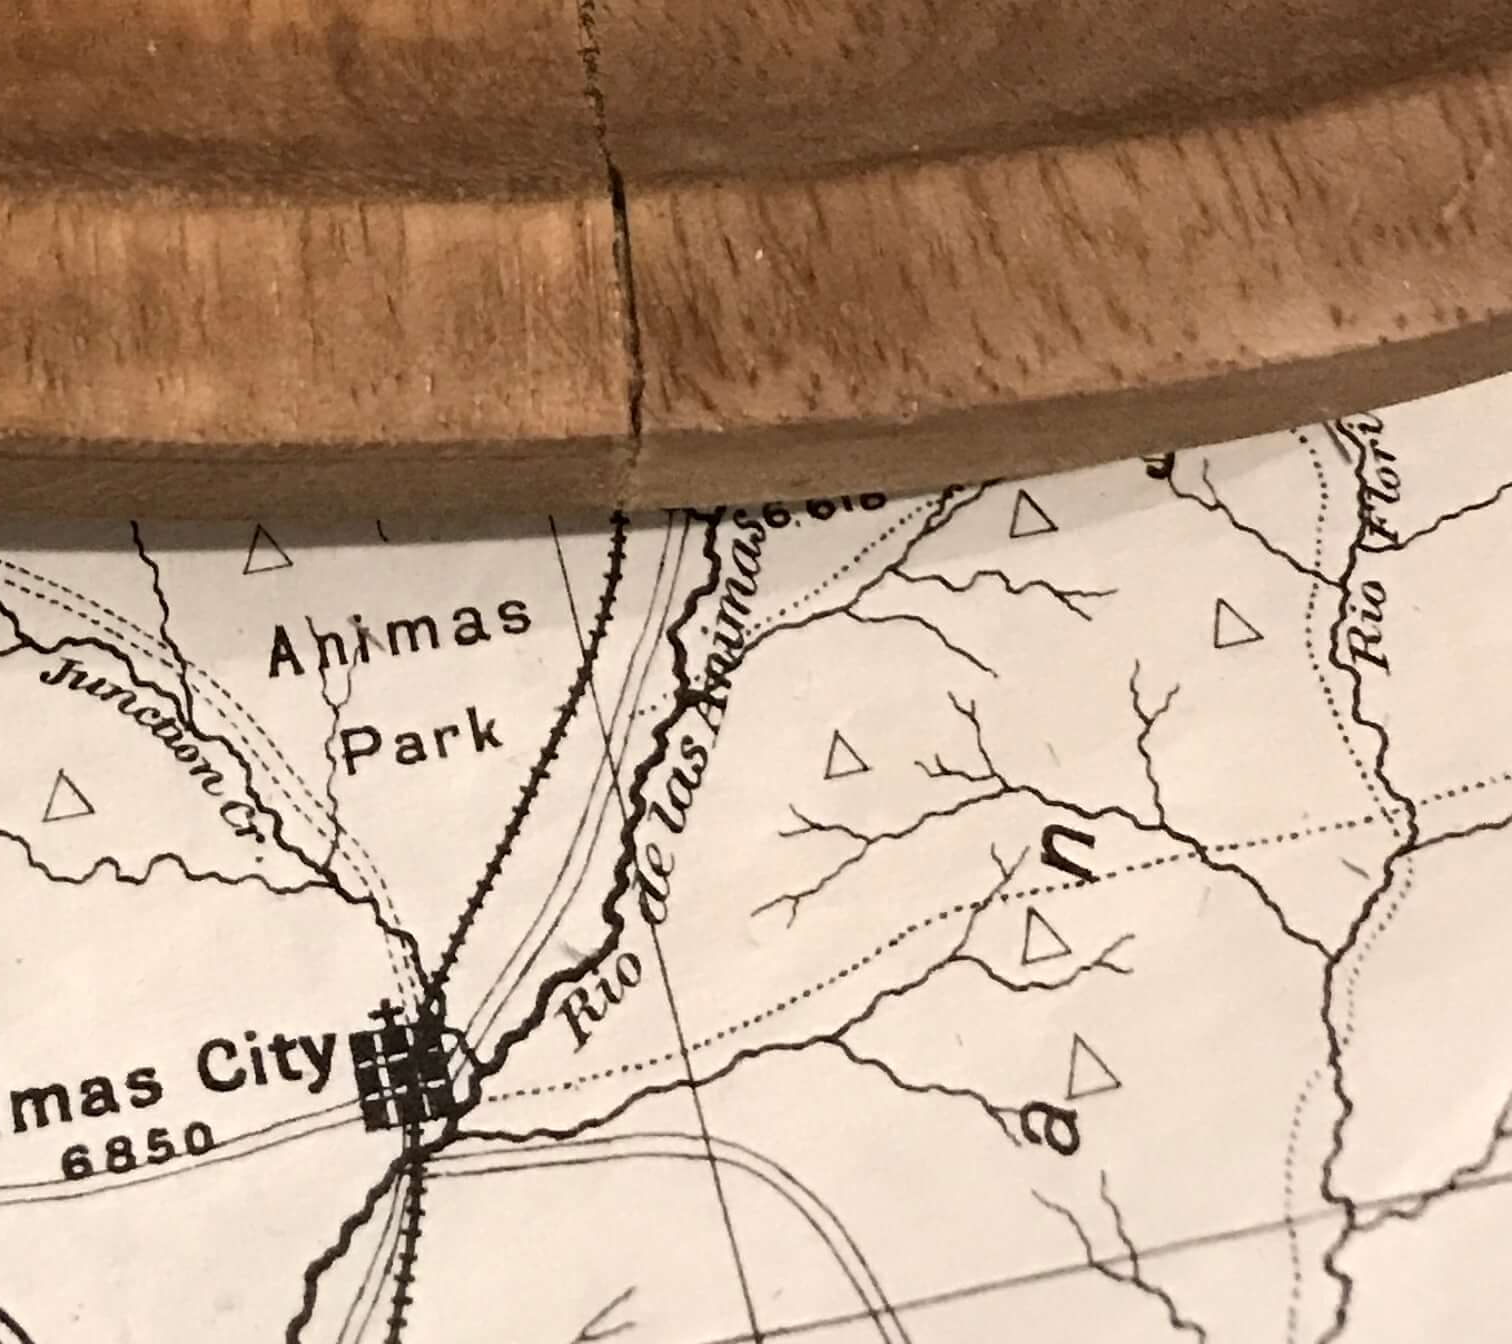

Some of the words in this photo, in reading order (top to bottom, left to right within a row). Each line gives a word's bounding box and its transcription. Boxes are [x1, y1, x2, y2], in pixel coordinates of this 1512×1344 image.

[269, 598, 532, 679] Animas
[678, 508, 766, 750] Animas
[1347, 581, 1391, 677] Rio
[40, 657, 224, 795] Junction
[339, 706, 503, 776] Park
[648, 735, 709, 833] las
[632, 843, 675, 924] de
[554, 953, 641, 1054] Rio
[197, 1030, 337, 1095] City
[61, 1121, 215, 1181] 6850
